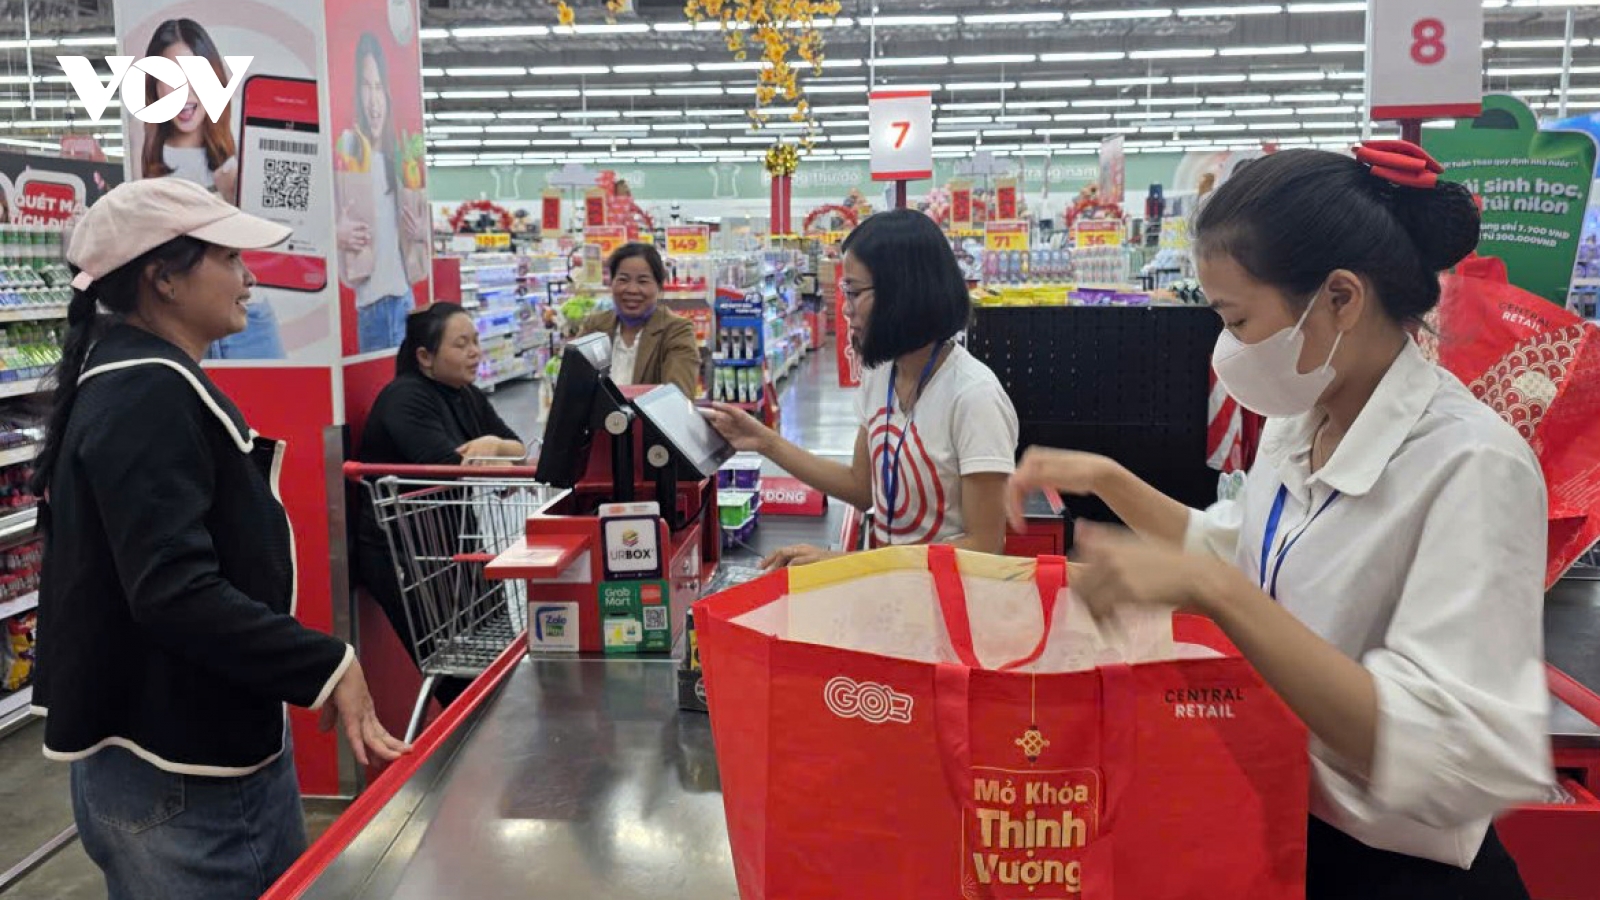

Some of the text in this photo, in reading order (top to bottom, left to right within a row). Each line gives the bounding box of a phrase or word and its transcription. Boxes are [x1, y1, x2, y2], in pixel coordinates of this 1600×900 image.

[1409, 17, 1447, 66] 8
[891, 121, 910, 149] 7
[1484, 177, 1531, 194] sinh
[1513, 193, 1569, 214] nilon
[670, 238, 698, 251] 149
[1502, 311, 1541, 334] RETAIL
[604, 587, 631, 597] Grab
[605, 596, 631, 607] Mart
[1164, 688, 1245, 704] CENTRAL
[1174, 703, 1236, 719] RETAIL
[1025, 780, 1090, 805] Khóa
[975, 807, 1087, 858] Thịnh
